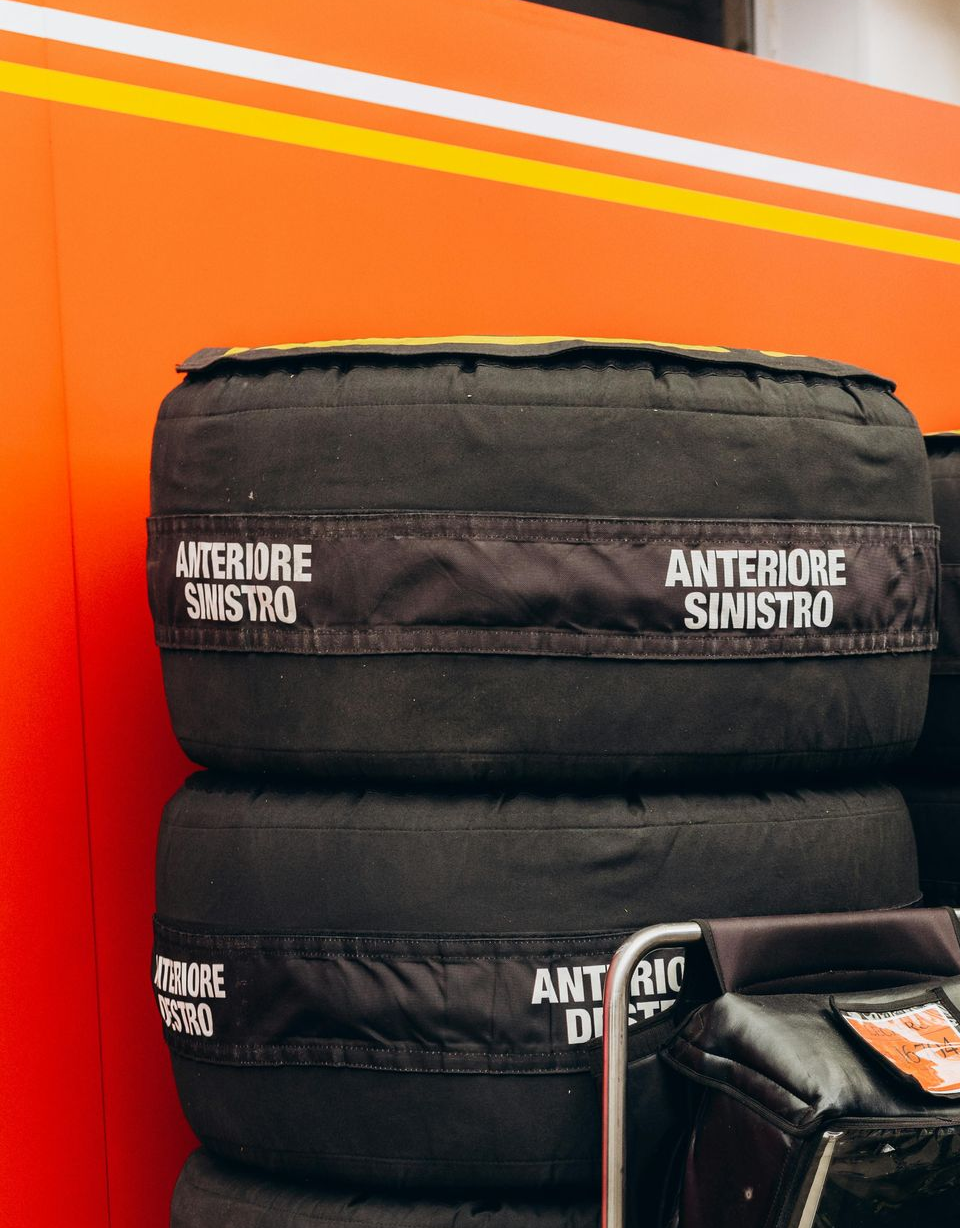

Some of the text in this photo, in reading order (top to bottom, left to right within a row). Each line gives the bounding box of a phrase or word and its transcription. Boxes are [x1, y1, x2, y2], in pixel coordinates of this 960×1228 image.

[175, 541, 312, 582] ANTERIORE
[665, 548, 846, 587] ANTERIORE
[185, 583, 297, 624] SINISTRO
[684, 591, 834, 630] SINISTRO
